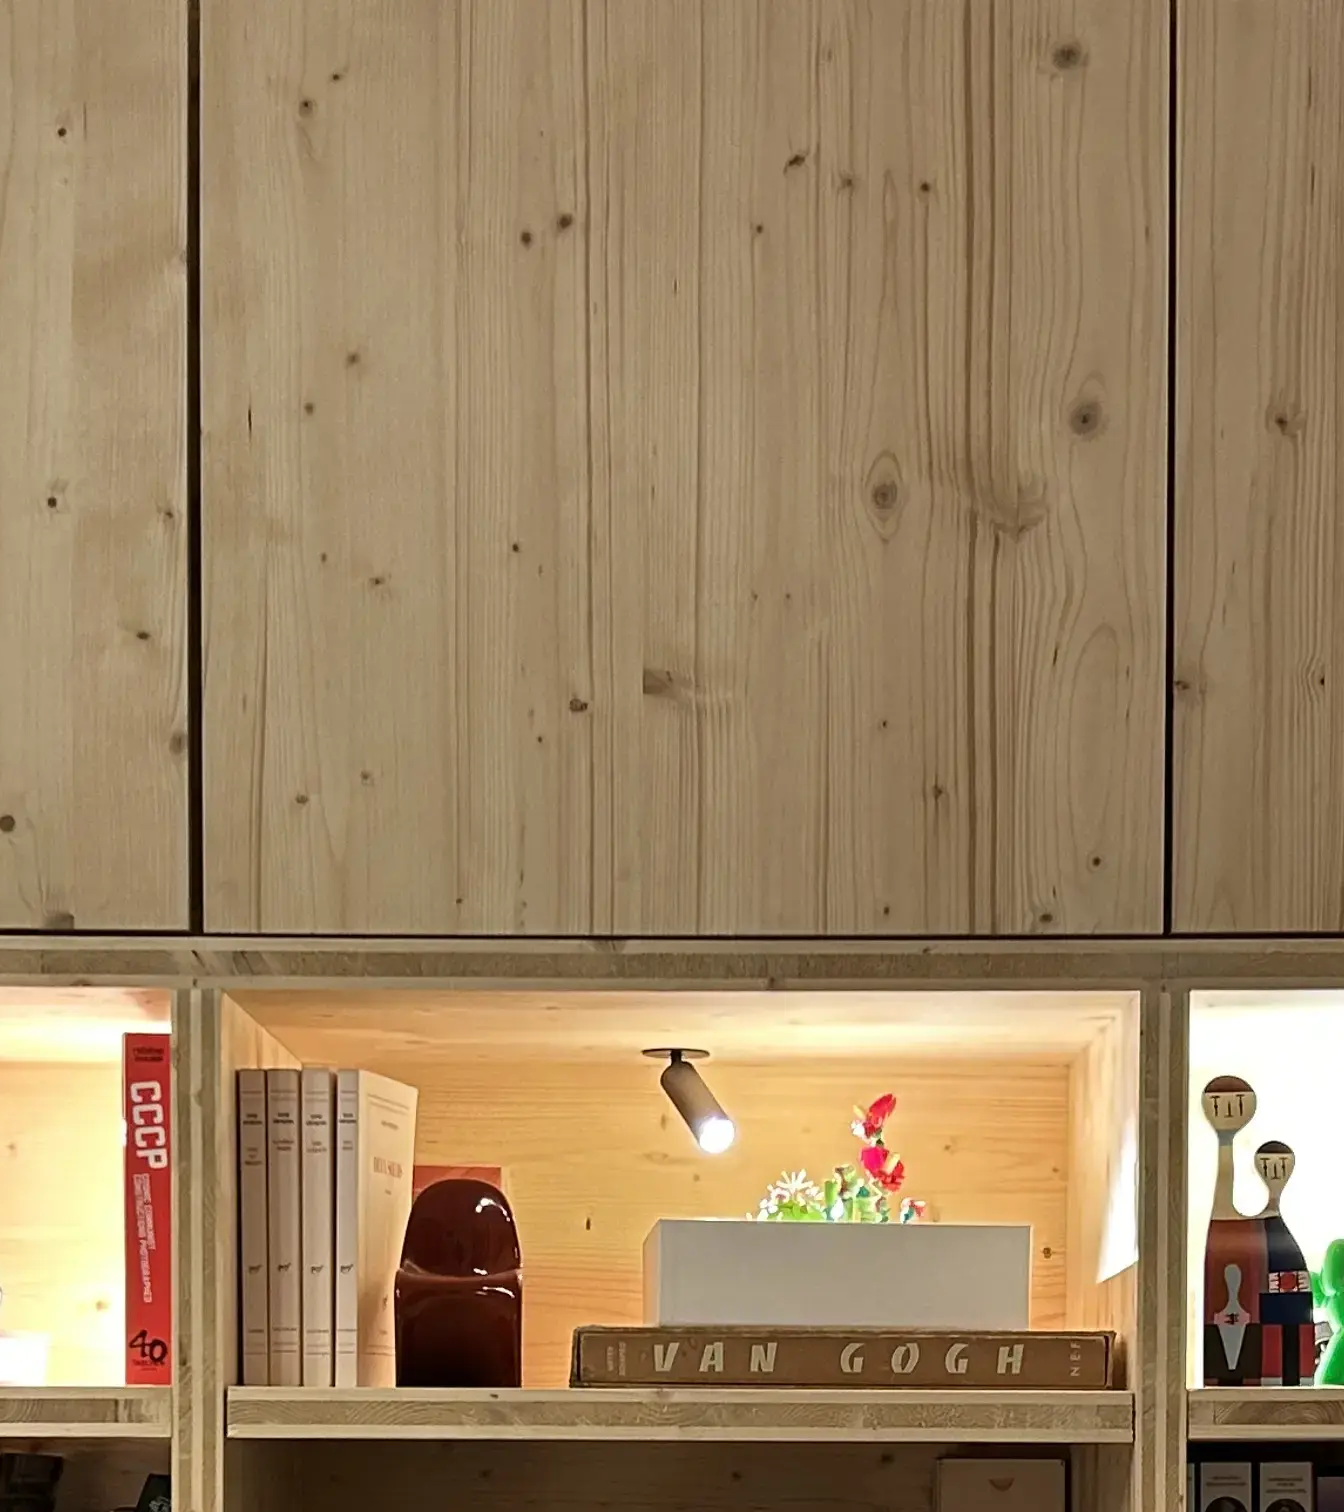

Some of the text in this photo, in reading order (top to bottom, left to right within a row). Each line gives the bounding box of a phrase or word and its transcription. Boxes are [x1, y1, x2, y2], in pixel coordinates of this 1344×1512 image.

[129, 1079, 168, 1170] CCCP
[652, 1341, 778, 1373] VAN
[839, 1342, 1026, 1375] GOGH
